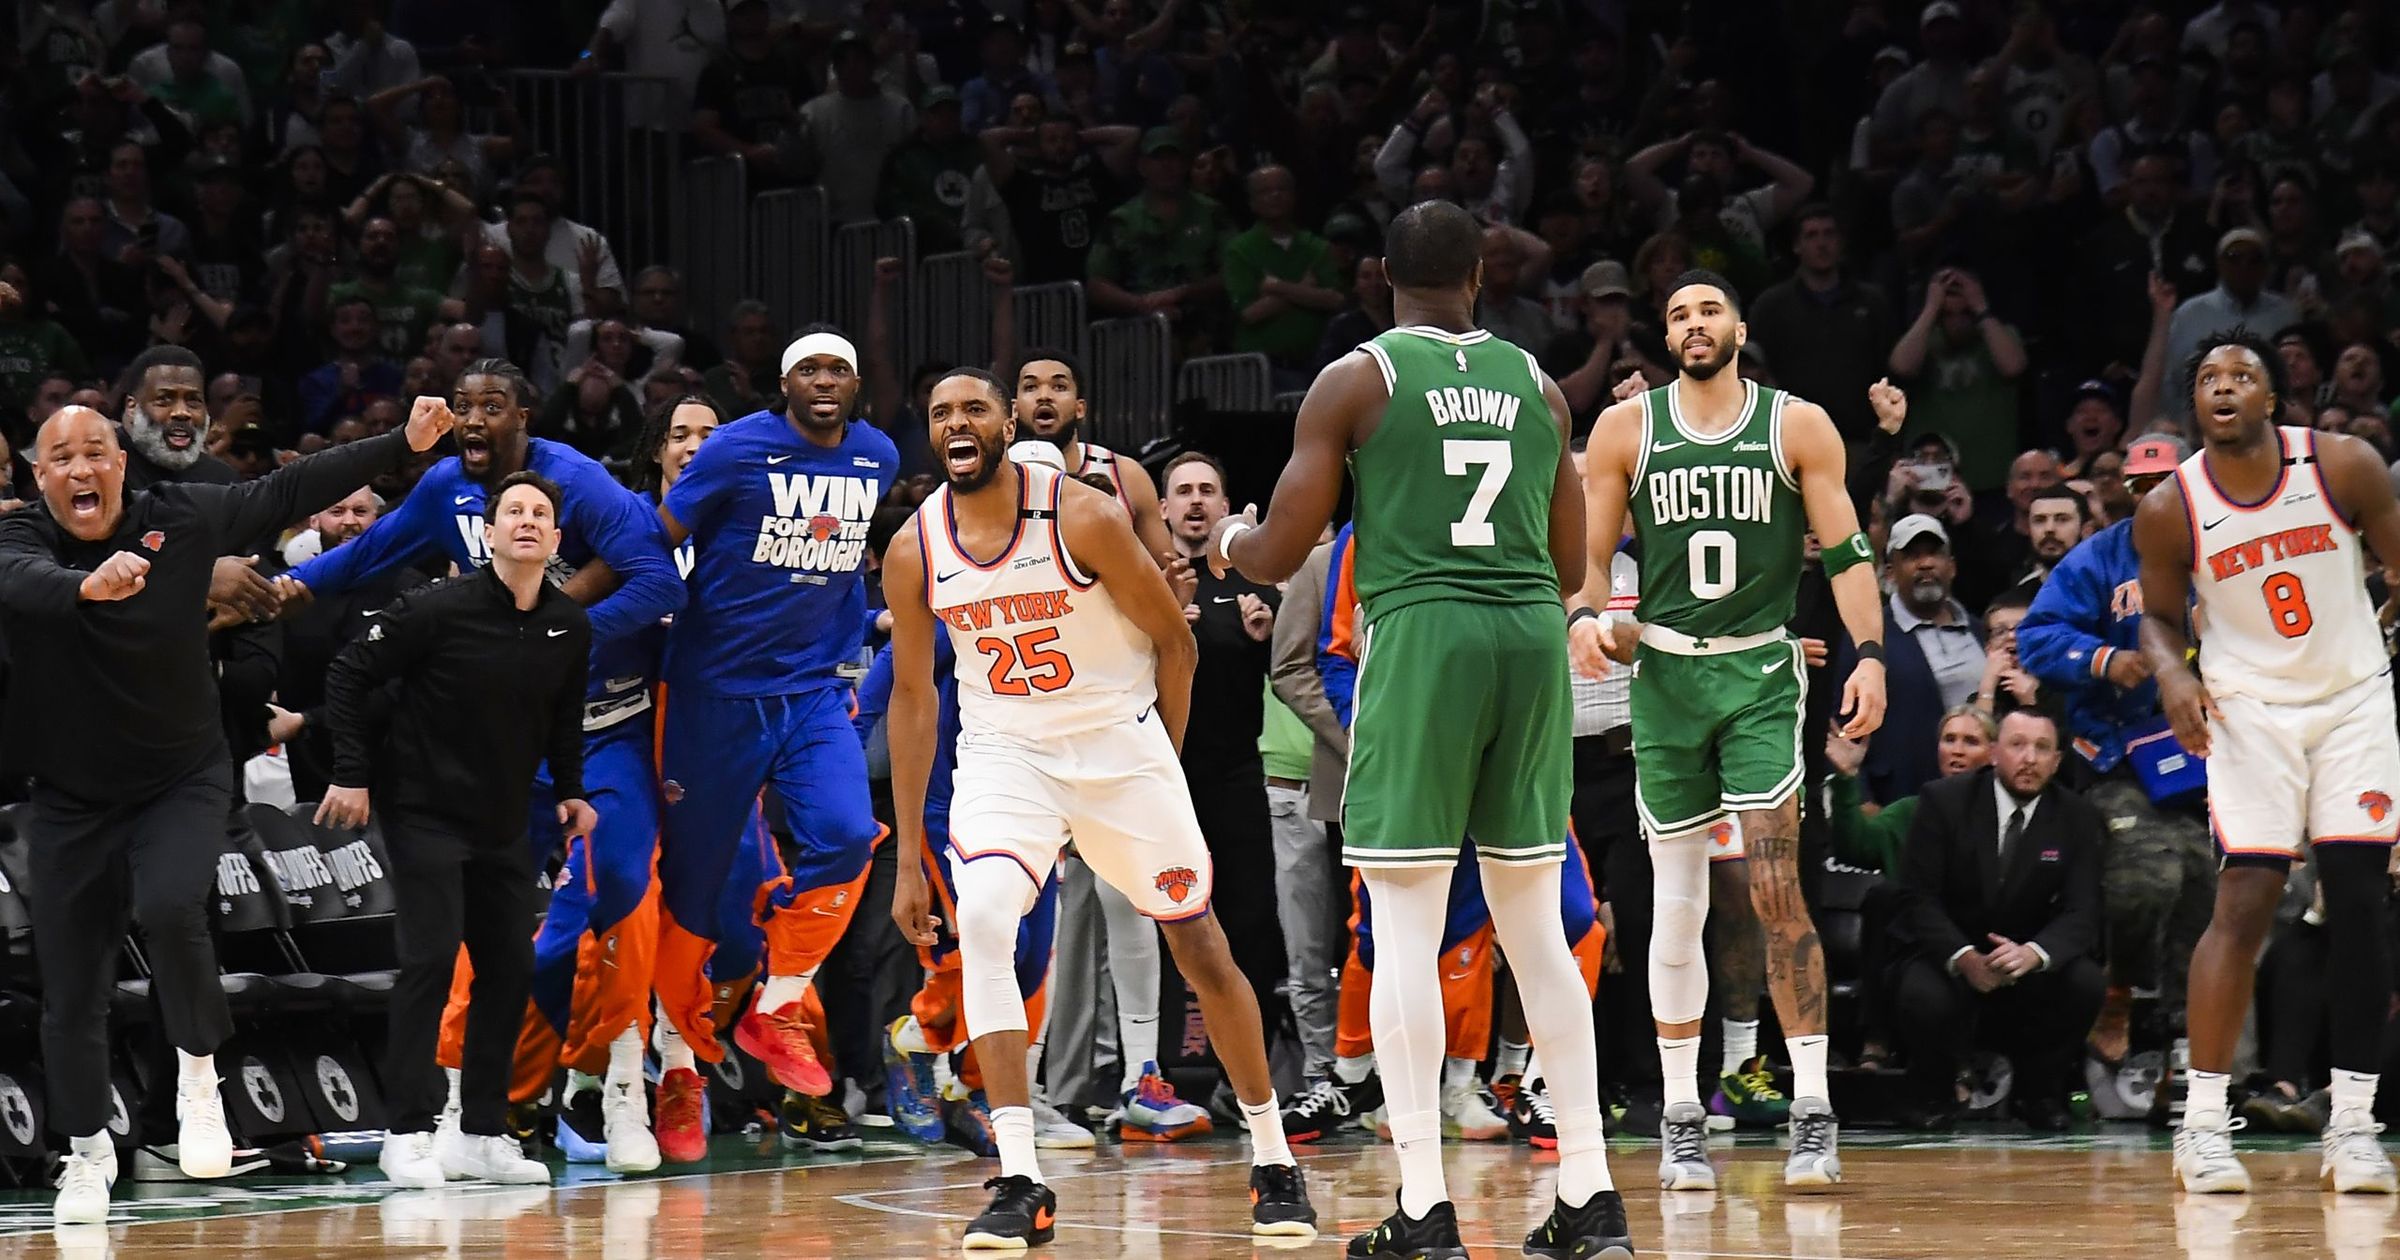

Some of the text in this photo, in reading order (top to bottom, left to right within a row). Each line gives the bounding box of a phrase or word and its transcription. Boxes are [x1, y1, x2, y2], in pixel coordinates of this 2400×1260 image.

[1425, 386, 1521, 432] BROWN
[1732, 440, 1769, 452] Amica
[767, 472, 879, 521] WIN
[1443, 439, 1513, 546] 7
[1649, 465, 1774, 526] BOSTON
[752, 533, 867, 572] BOROUGHS
[761, 515, 871, 540] FOR THE
[2206, 523, 2338, 583] NEW YORK
[1688, 530, 1737, 600] 0
[994, 589, 1074, 625] YORK
[2261, 571, 2313, 639] 8
[975, 626, 1074, 696] 25
